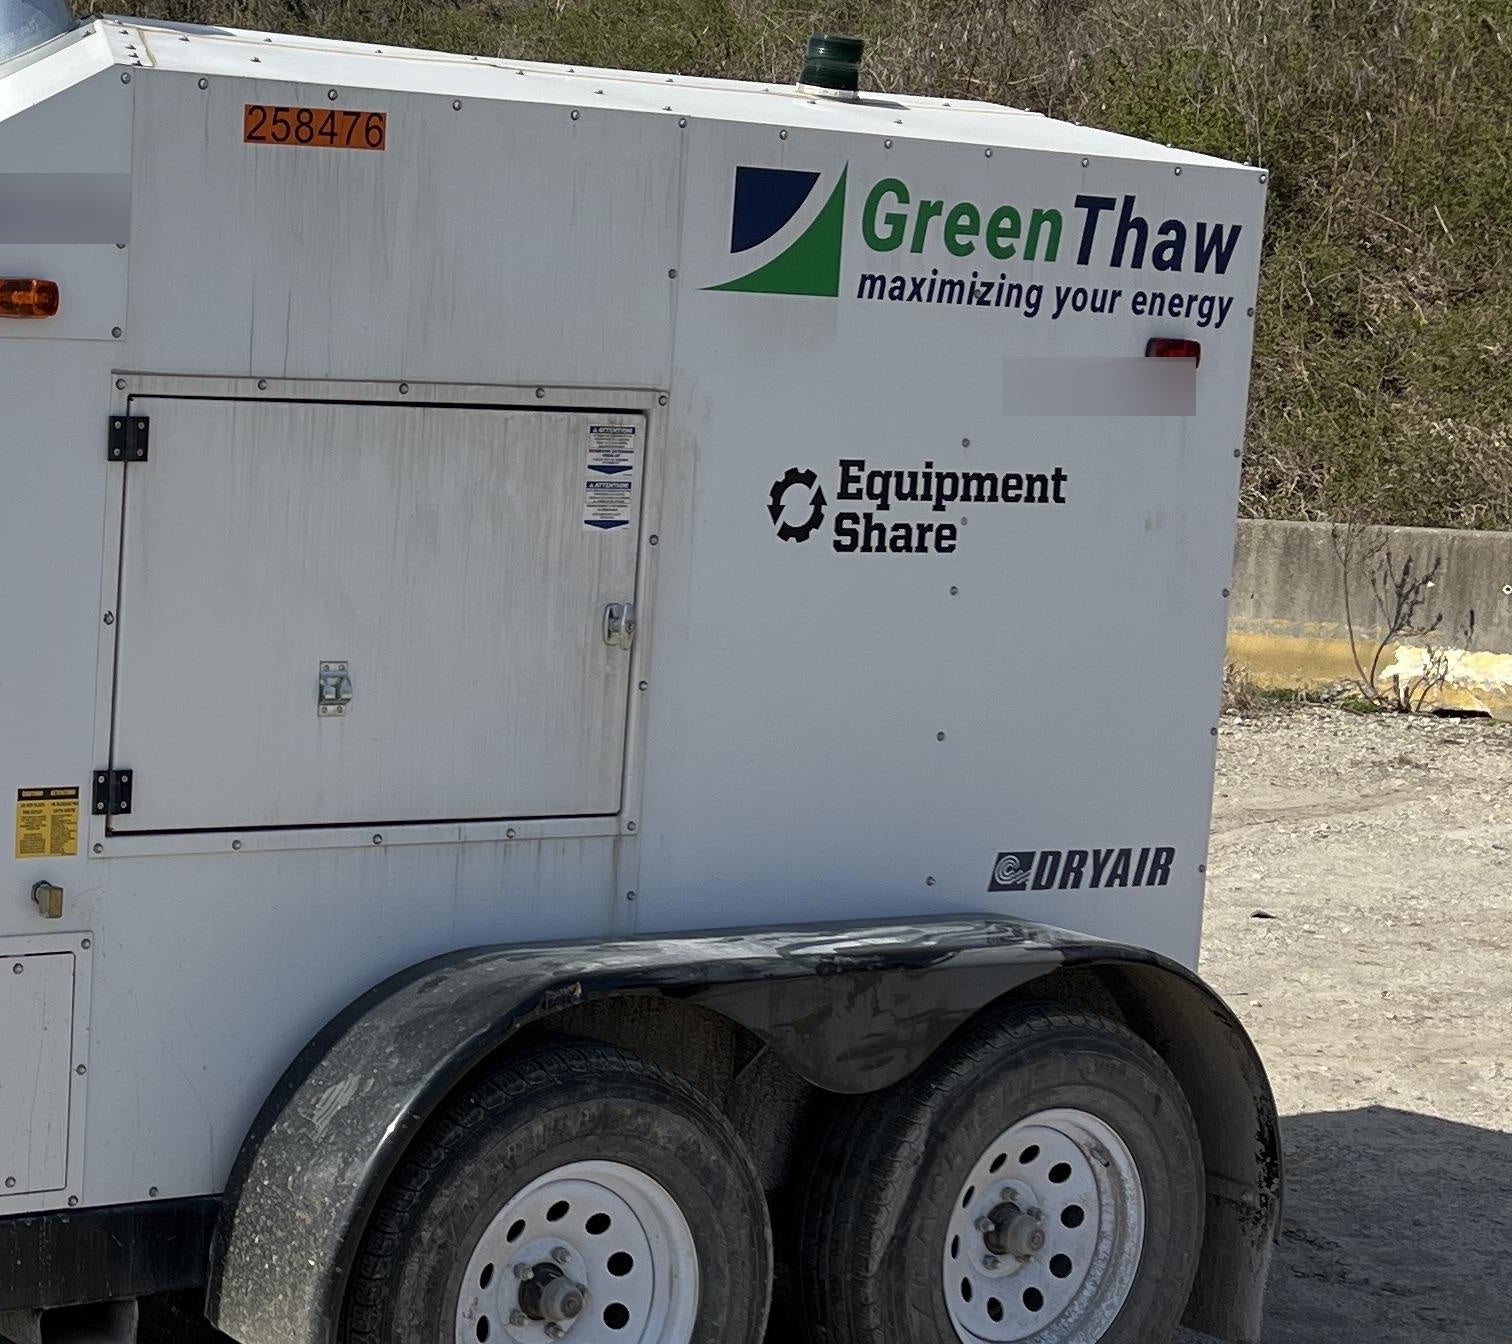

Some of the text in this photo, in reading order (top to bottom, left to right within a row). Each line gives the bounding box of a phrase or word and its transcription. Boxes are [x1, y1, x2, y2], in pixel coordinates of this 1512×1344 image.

[246, 105, 384, 148] 258476
[856, 268, 1234, 329] maximizing your energy
[836, 458, 1068, 512] Equipment
[833, 511, 958, 554] Share
[1031, 846, 1176, 891] DRYAIR
